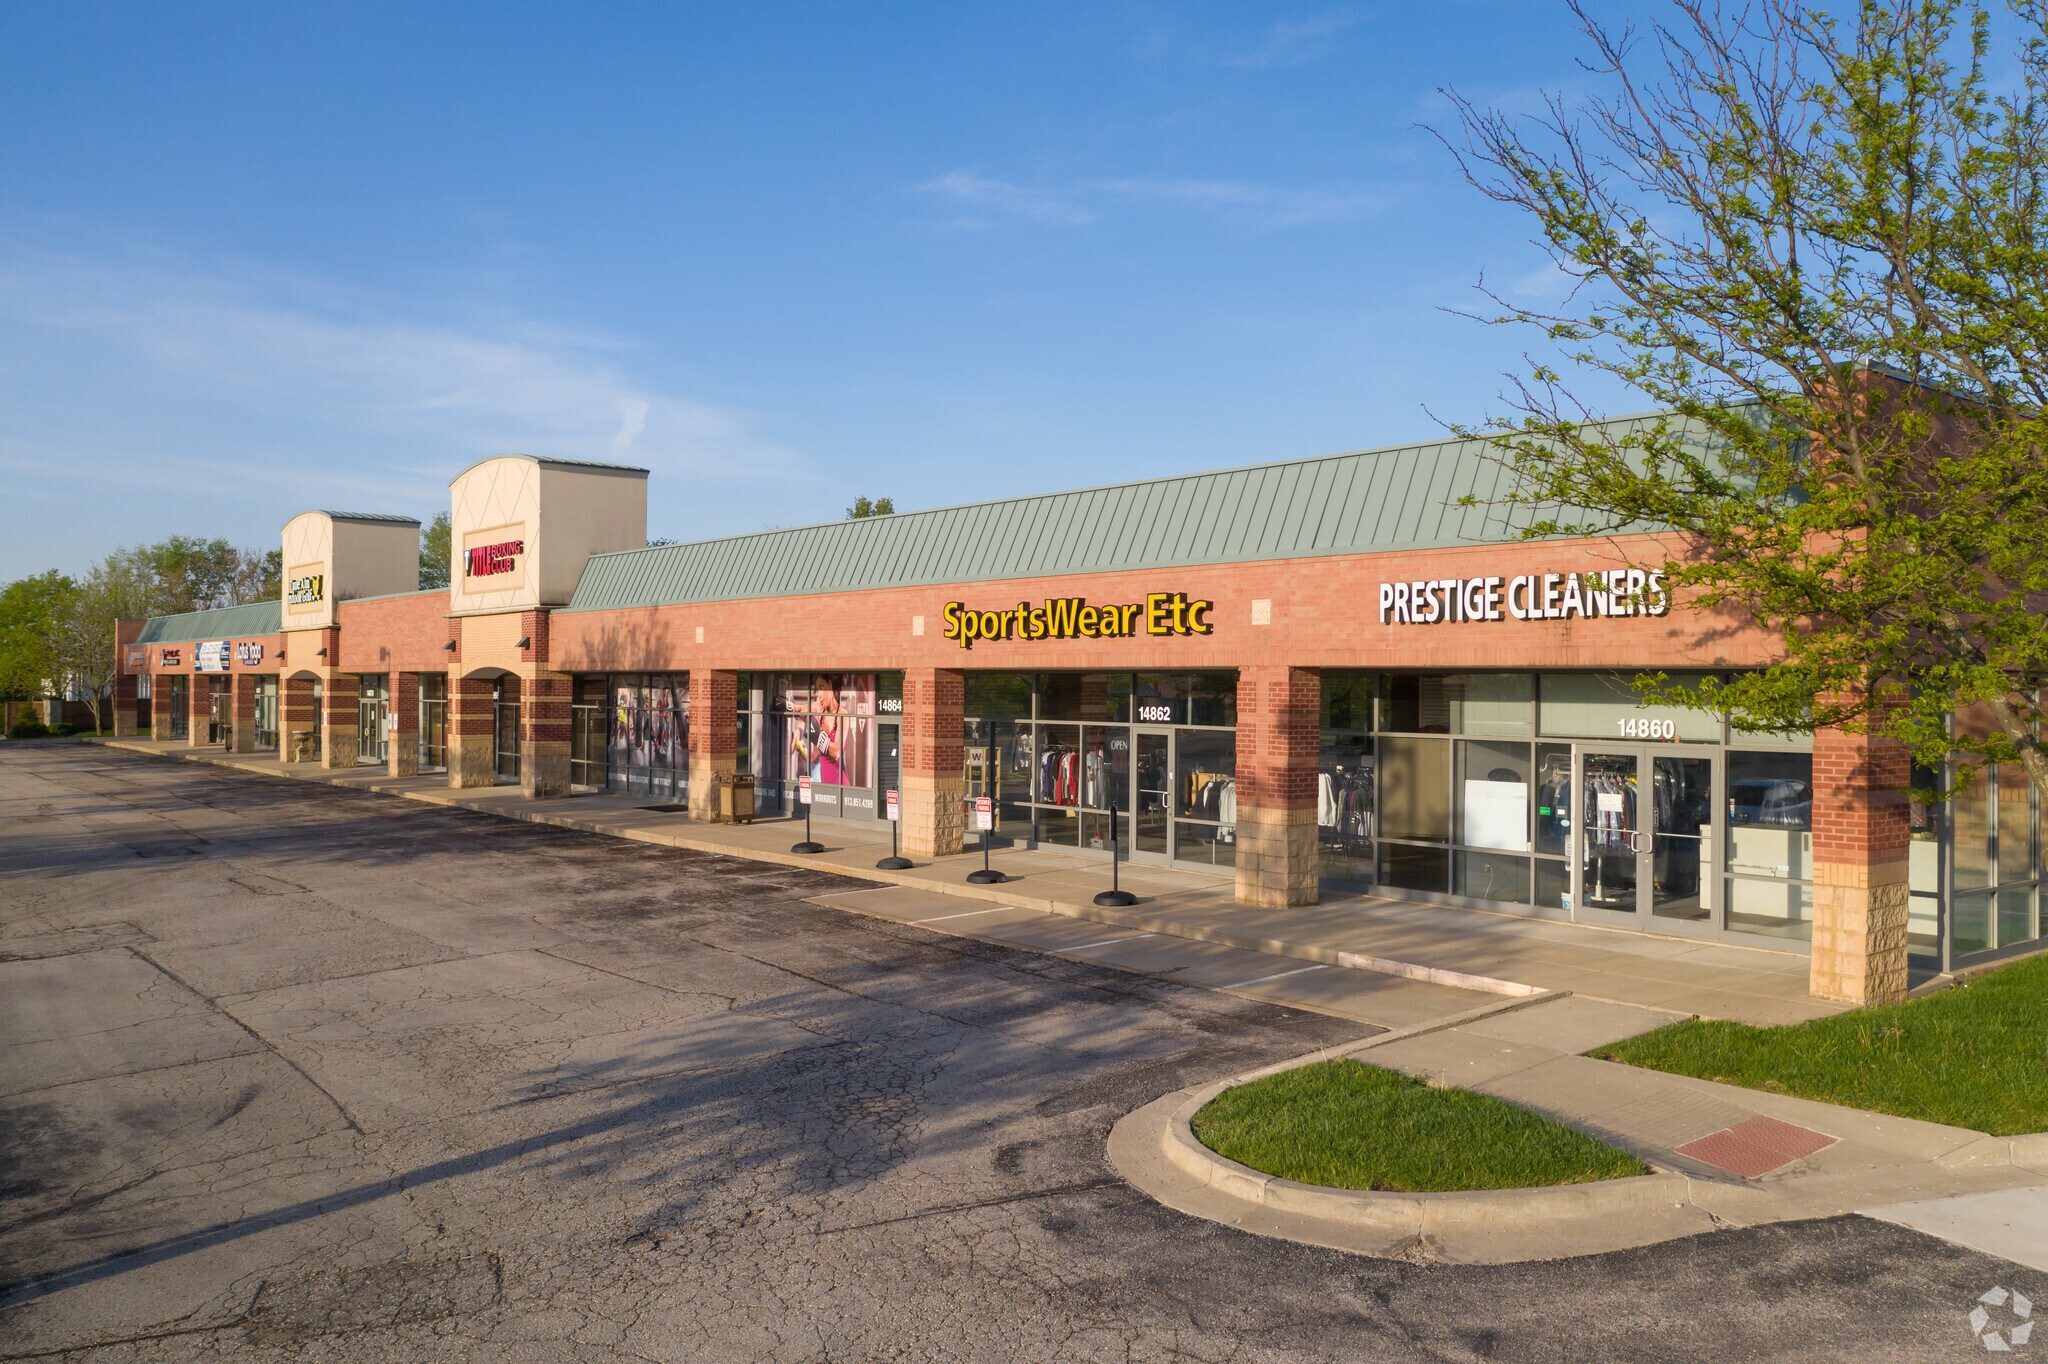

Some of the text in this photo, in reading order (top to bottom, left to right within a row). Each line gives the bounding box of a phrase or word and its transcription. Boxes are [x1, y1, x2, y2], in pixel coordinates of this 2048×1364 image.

[491, 540, 521, 557] BOXING
[472, 547, 490, 576] TITLE
[491, 558, 512, 573] CLUB
[1379, 568, 1668, 624] PRESTIGE CLEANERS
[943, 593, 1209, 649] SportsWear Etc
[878, 699, 902, 712] 14864
[1139, 706, 1171, 720] 14862
[1617, 719, 1675, 739] 14860
[1110, 739, 1128, 751] OPEN
[814, 793, 837, 804] WORKOUTS
